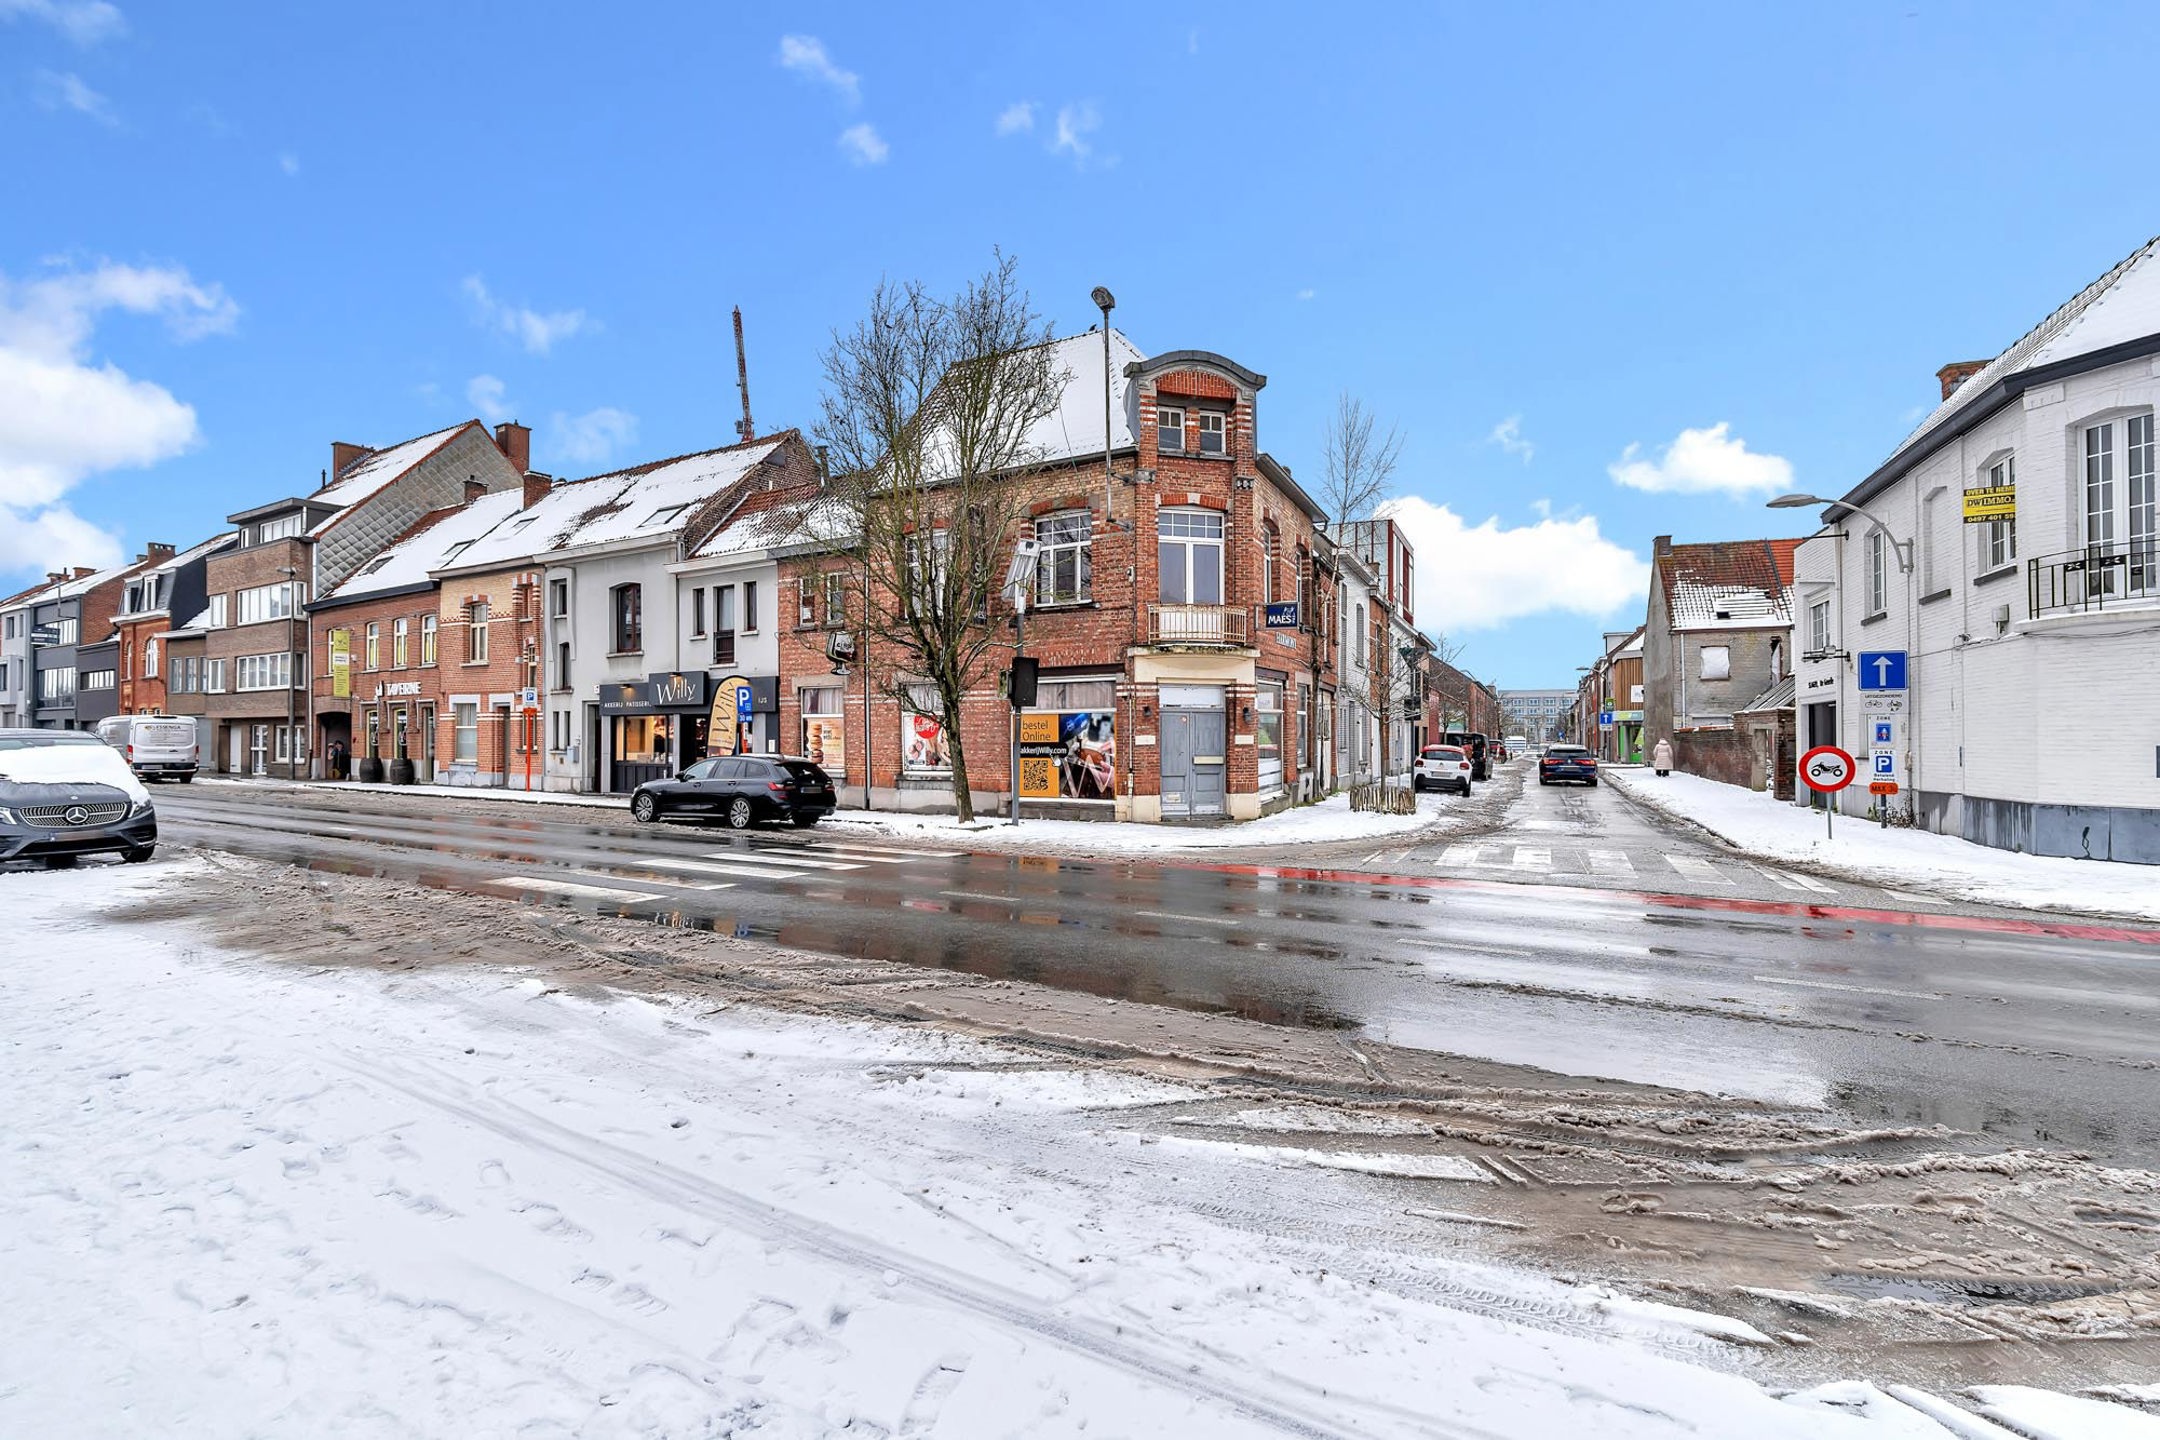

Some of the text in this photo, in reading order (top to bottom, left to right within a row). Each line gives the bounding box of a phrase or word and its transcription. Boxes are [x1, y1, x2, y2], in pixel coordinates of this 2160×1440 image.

[1268, 615, 1292, 625] MAES
[385, 682, 422, 697] TAVERNE
[656, 677, 696, 705] Willy
[738, 688, 749, 707] P
[626, 700, 652, 708] PATISSERI
[712, 681, 735, 732] Willy
[1022, 719, 1049, 730] bestel
[1022, 732, 1051, 741] Online
[1020, 746, 1067, 755] akkerijWilly.com
[1877, 757, 1890, 771] P
